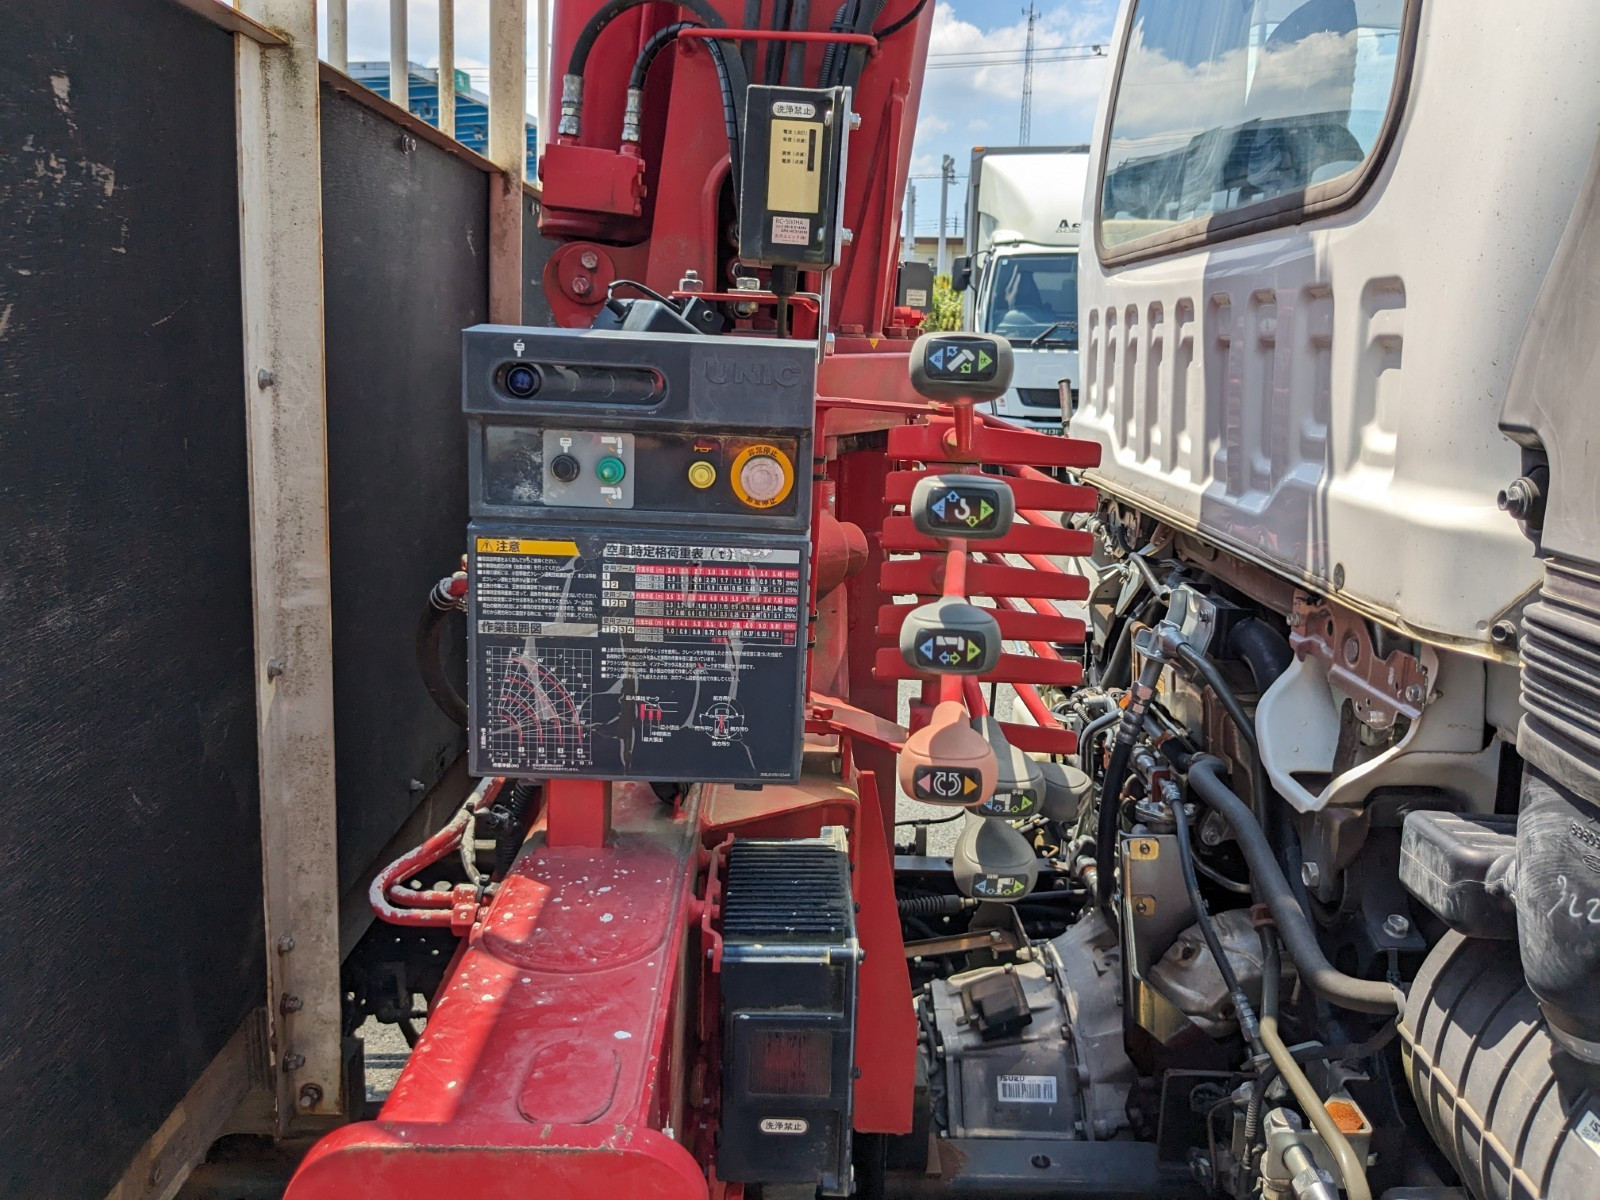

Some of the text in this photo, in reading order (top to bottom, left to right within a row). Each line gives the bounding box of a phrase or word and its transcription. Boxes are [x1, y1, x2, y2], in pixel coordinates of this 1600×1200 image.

[777, 106, 812, 115] 洗浄禁止
[705, 360, 801, 387] UNIC
[496, 541, 520, 552] 注意
[482, 621, 542, 634] 作業範囲図
[766, 1122, 802, 1130] 洗浄禁止
